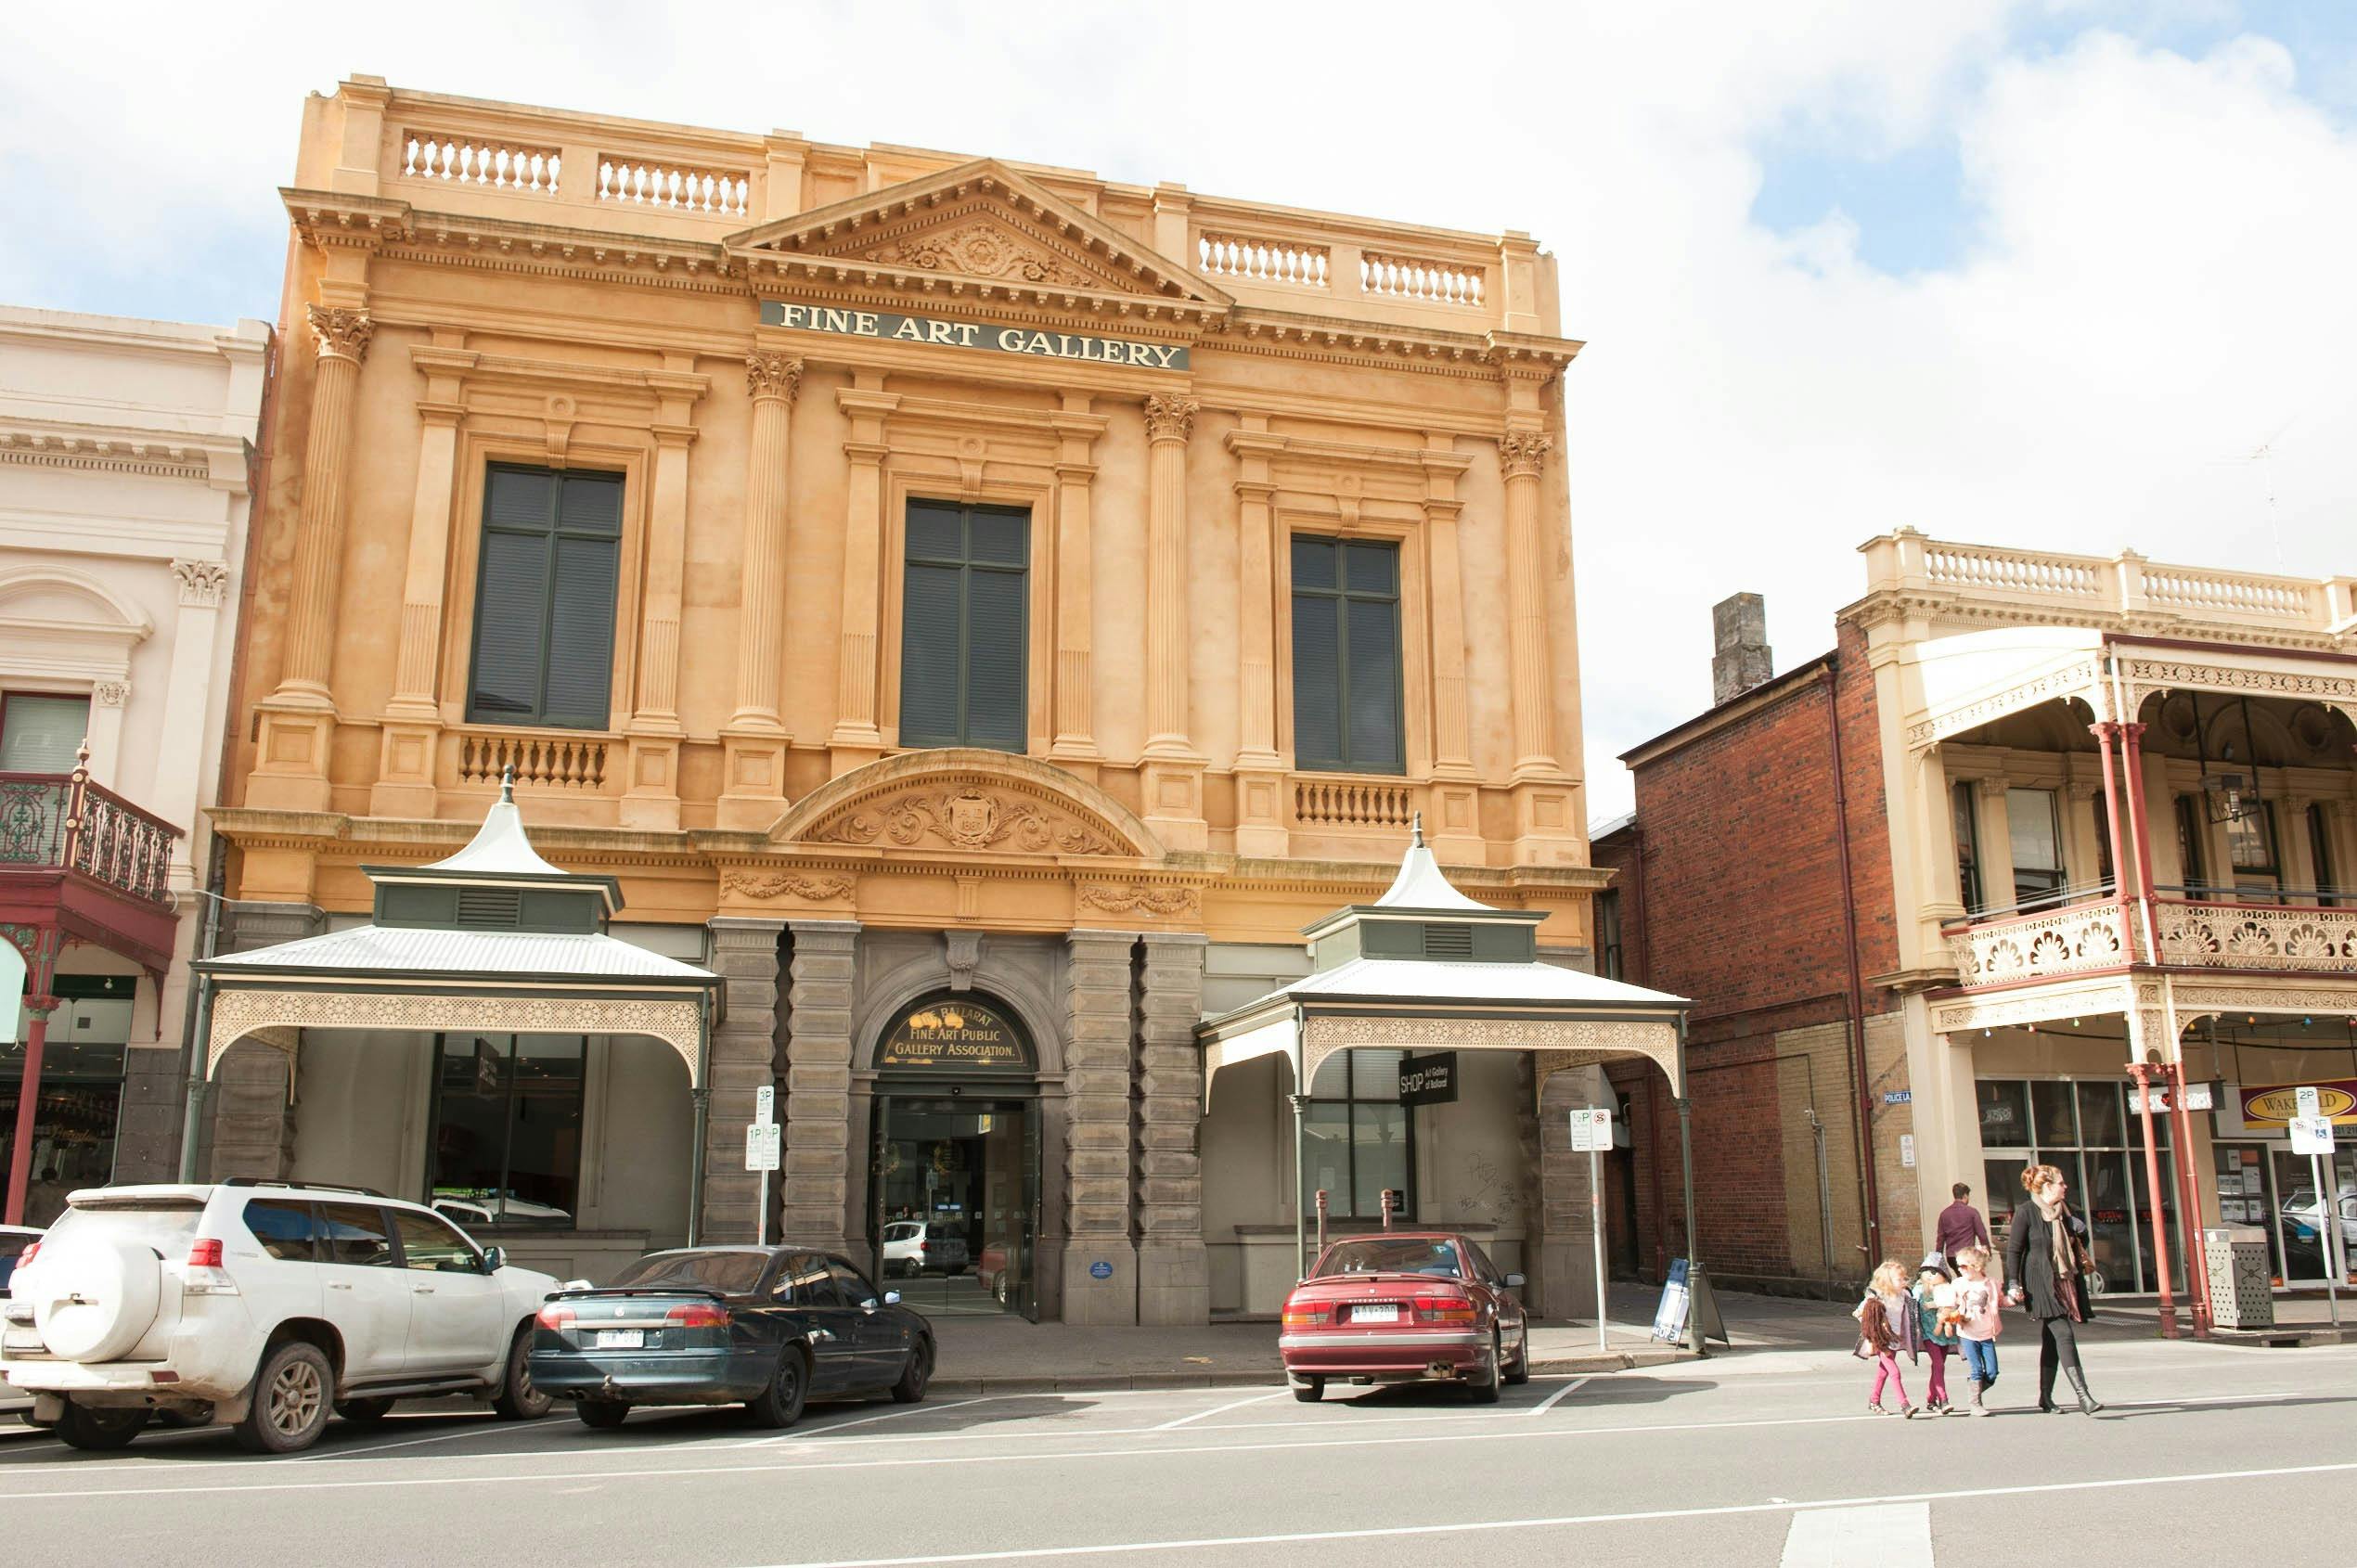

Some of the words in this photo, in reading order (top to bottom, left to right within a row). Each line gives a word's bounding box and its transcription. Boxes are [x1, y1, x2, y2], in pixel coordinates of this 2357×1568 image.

[780, 303, 879, 337] FINE
[892, 317, 979, 347] ART
[998, 329, 1180, 368] GALLERY
[941, 1007, 993, 1027] BALLARAT
[910, 1028, 934, 1040] FINE
[937, 1029, 959, 1040] ART
[961, 1029, 1000, 1041] PUBLIC
[895, 1043, 943, 1055] GALLERY
[947, 1044, 1015, 1057] ASSOCIATION.
[1400, 1073, 1423, 1093] SHOP
[2262, 1093, 2337, 1111] WAKELD
[2299, 1090, 2314, 1099] 2P
